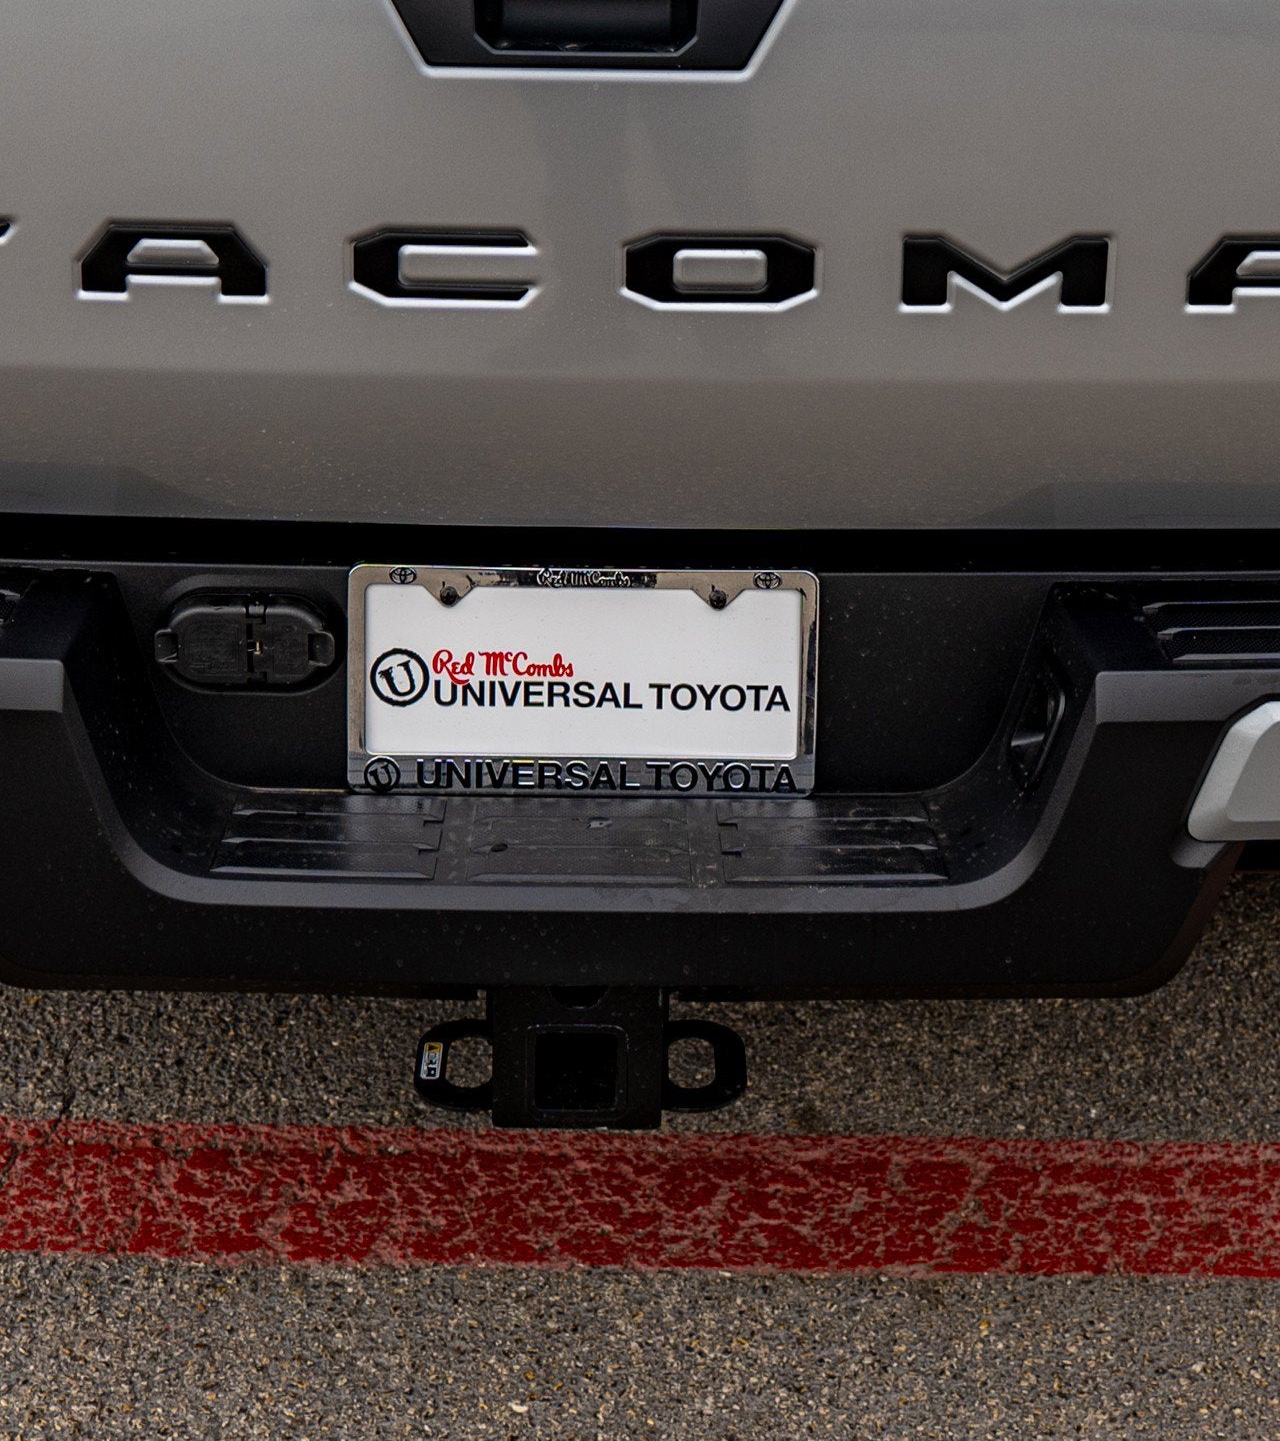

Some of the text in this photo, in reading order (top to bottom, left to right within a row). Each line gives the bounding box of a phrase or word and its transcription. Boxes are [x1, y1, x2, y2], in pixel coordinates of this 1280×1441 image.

[431, 649, 575, 686] Red McCombs
[434, 679, 791, 712] UNIVERSAL TOYOTA
[417, 759, 798, 793] UNIVERSAL TOYOTA
